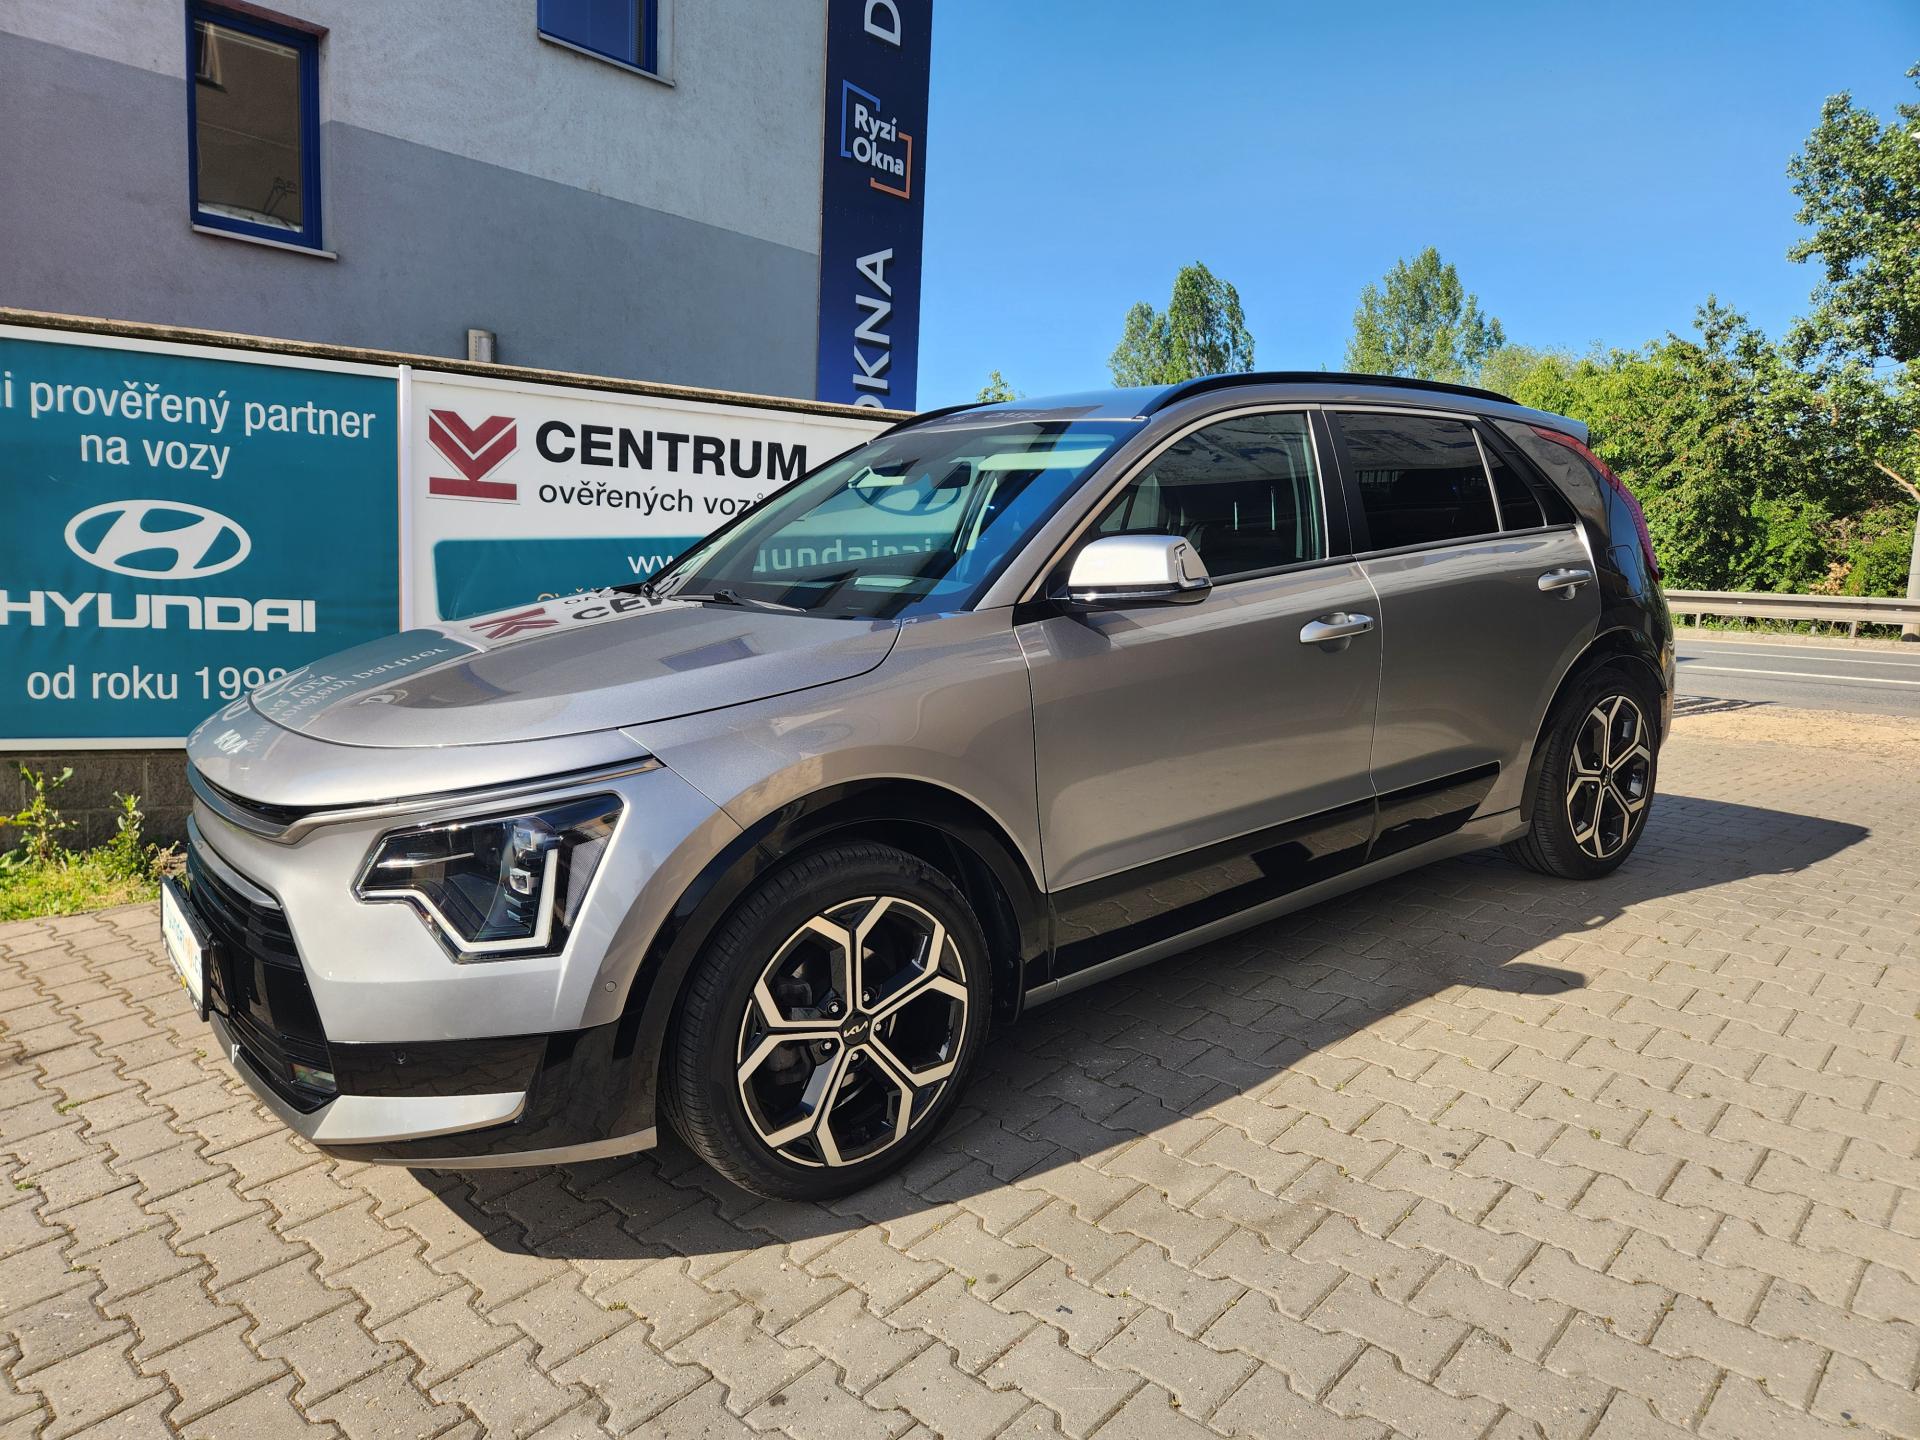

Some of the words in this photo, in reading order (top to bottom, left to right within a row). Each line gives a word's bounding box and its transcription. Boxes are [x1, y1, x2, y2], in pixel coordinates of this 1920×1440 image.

[854, 103, 897, 142] Ryzí
[852, 136, 904, 176] Okna
[30, 380, 227, 433] prověřený
[245, 399, 376, 438] partner
[80, 434, 129, 465] na
[143, 439, 230, 480] vozy
[535, 420, 807, 482] CENTRUM
[538, 481, 693, 516] ověřených
[0, 589, 316, 633] HYUNDAI
[27, 665, 75, 700] od
[92, 665, 180, 700] roku
